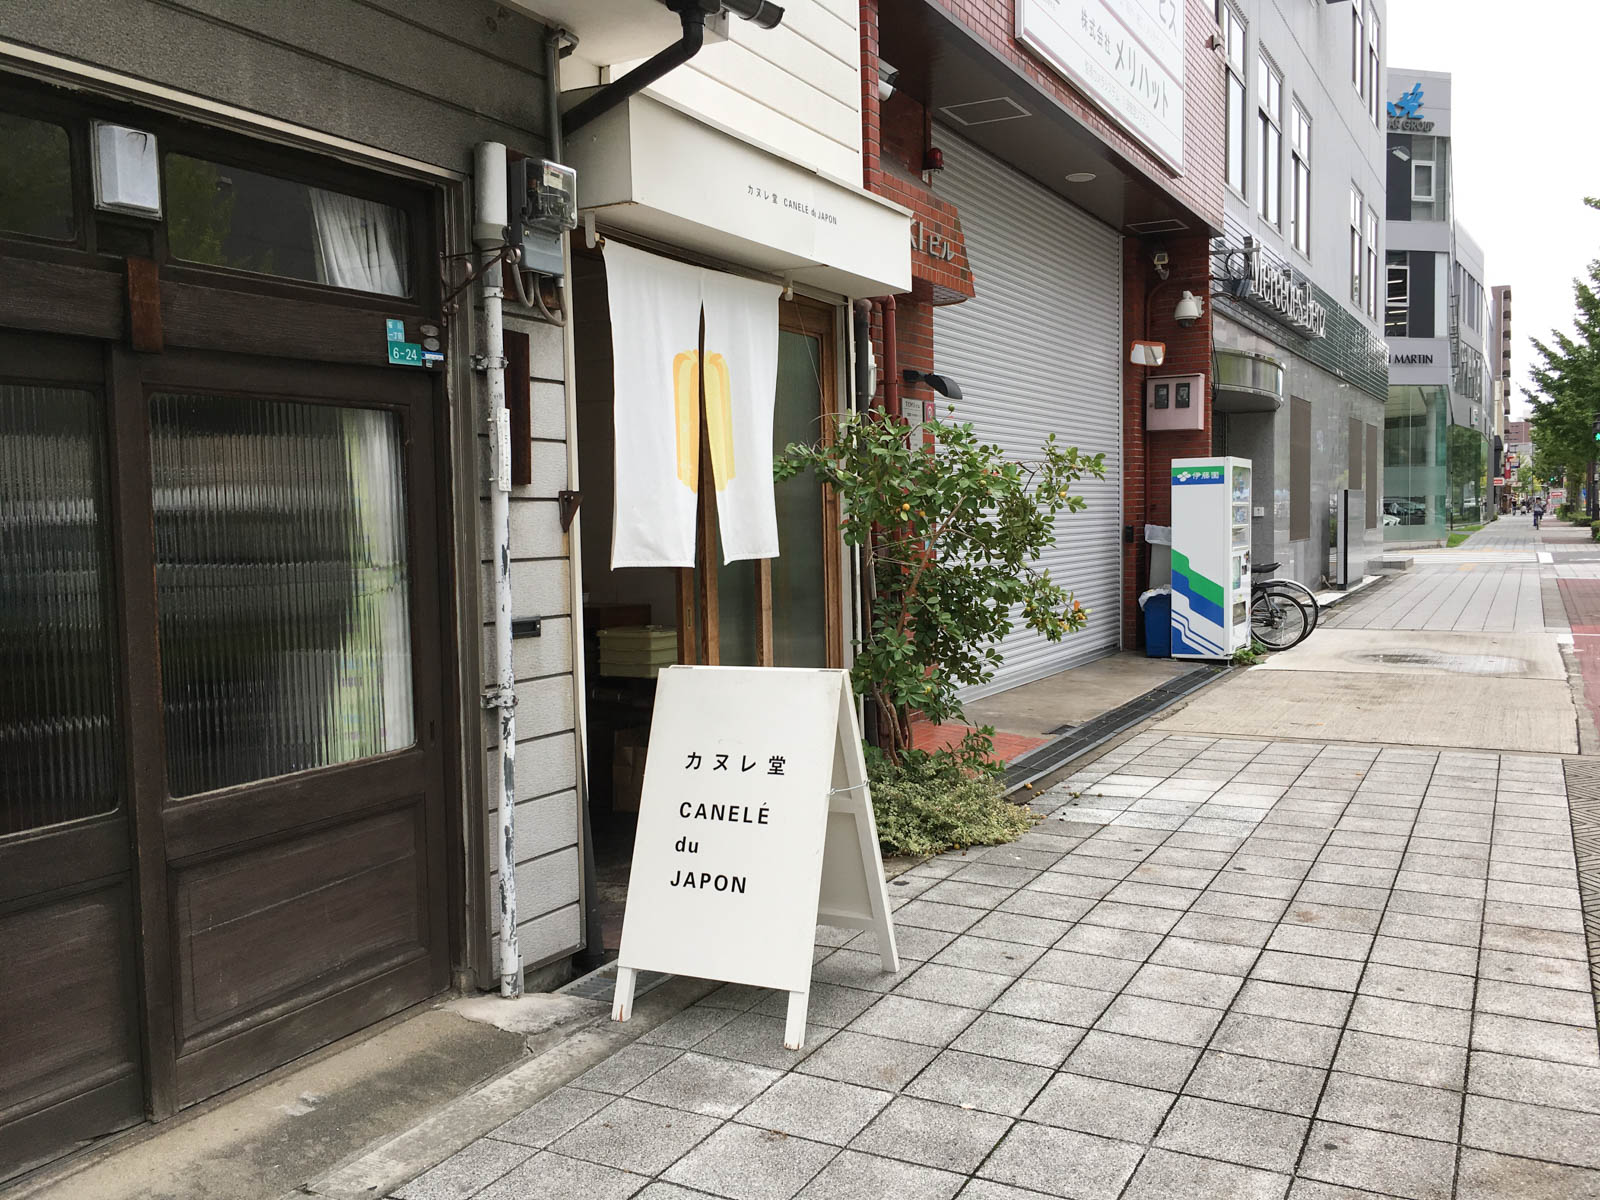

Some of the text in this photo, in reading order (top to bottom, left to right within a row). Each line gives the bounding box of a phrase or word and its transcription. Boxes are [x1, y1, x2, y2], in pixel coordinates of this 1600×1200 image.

[1081, 7, 1111, 56] 株式会社
[1114, 39, 1168, 119] メリハット
[1401, 120, 1436, 133] GROUP
[747, 184, 778, 205] カヌレ堂
[817, 211, 837, 225] JAPON
[929, 234, 955, 261] ビル
[393, 346, 418, 361] 6-24
[1394, 353, 1433, 364] MARTIN
[684, 751, 786, 776] カヌレ堂
[679, 801, 770, 825] CANELÉ
[674, 836, 699, 854] du
[669, 870, 747, 894] JAPON
